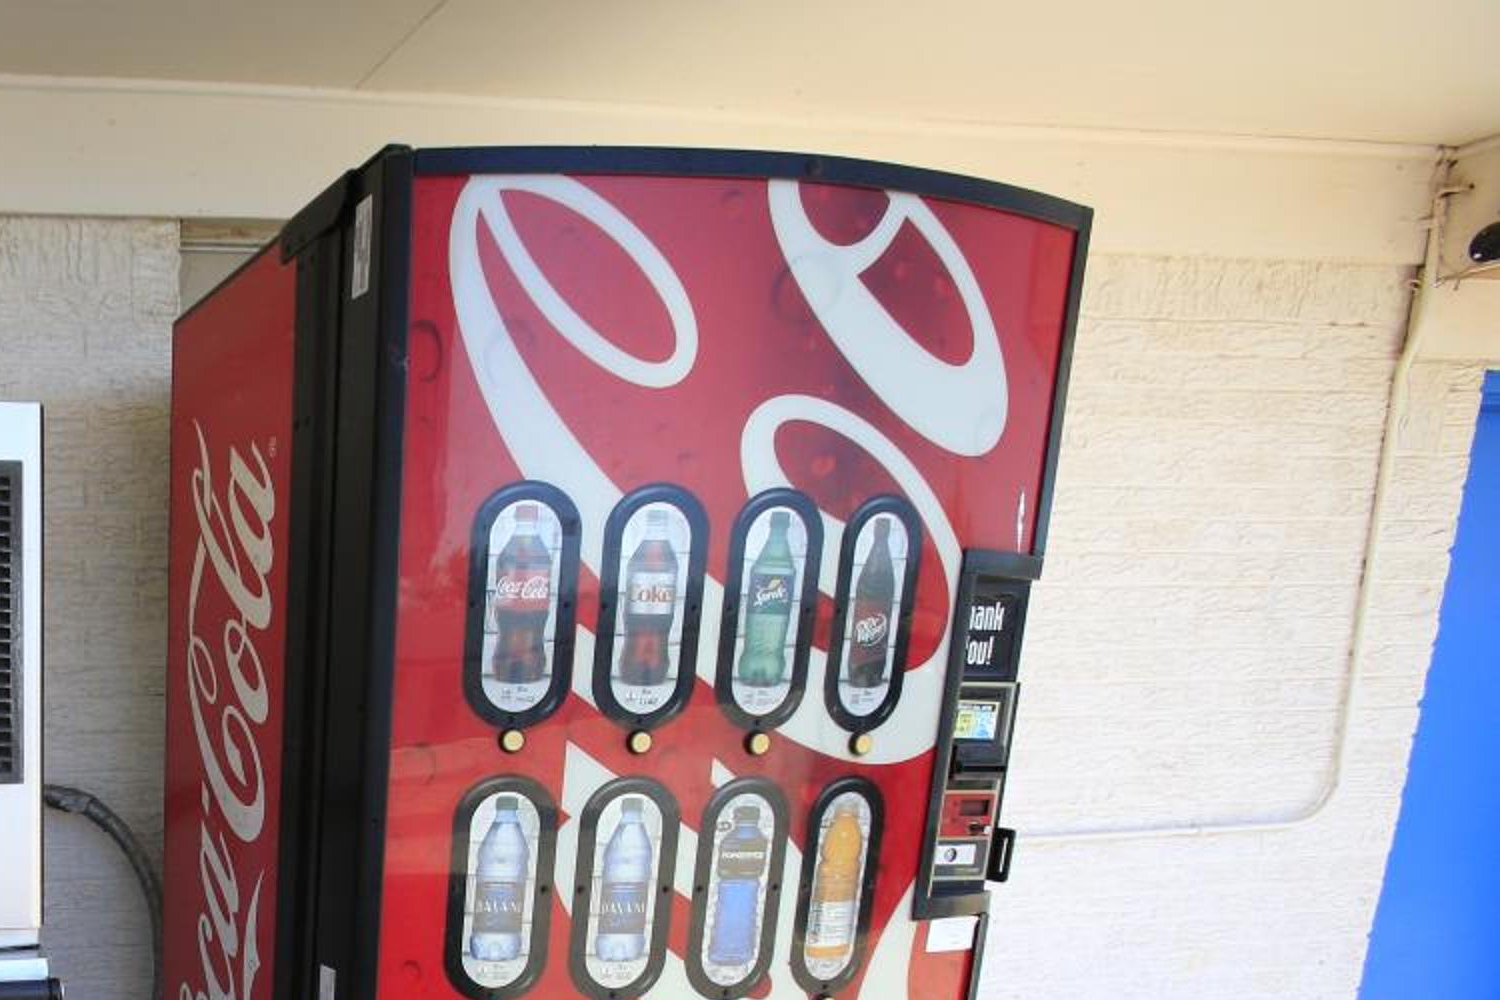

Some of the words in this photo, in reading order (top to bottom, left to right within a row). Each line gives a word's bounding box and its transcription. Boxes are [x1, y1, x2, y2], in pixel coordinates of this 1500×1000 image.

[753, 587, 788, 607] Sprite
[969, 602, 1005, 631] ank
[966, 636, 995, 665] ou!
